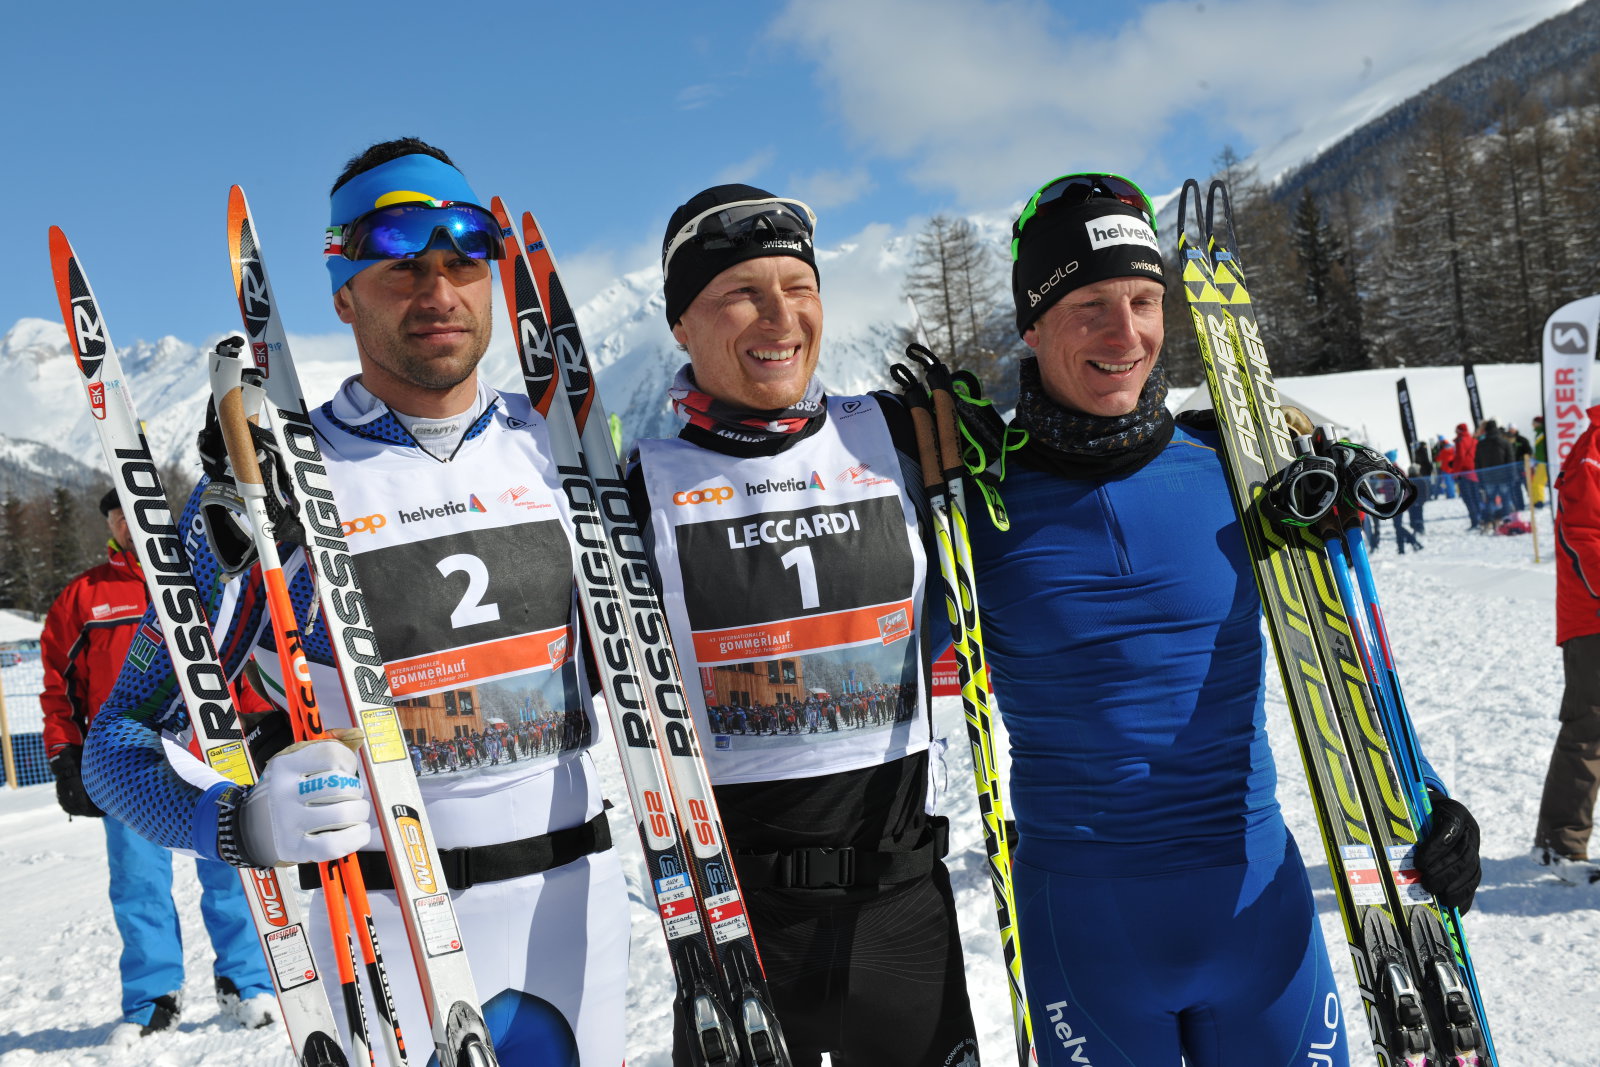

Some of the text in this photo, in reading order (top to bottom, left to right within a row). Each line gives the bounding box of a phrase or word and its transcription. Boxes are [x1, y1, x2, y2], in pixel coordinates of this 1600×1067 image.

[1040, 260, 1079, 295] odlo
[1207, 315, 1265, 464] FISCHER
[1239, 316, 1297, 462] FISCHER
[1555, 368, 1584, 470] ONSER
[398, 501, 467, 524] helvetia
[672, 486, 734, 505] coop
[745, 477, 806, 497] helvetia
[277, 398, 396, 706] ROSSIGNOL
[340, 514, 387, 535] oop
[727, 509, 861, 550] LECCARDI
[113, 433, 244, 739] ROSSIGNOL
[435, 553, 501, 629] 2
[558, 451, 657, 749] ROSSIGNOL
[596, 464, 700, 758] ROSSIGNOL
[780, 545, 821, 610] 1
[247, 726, 262, 745] port
